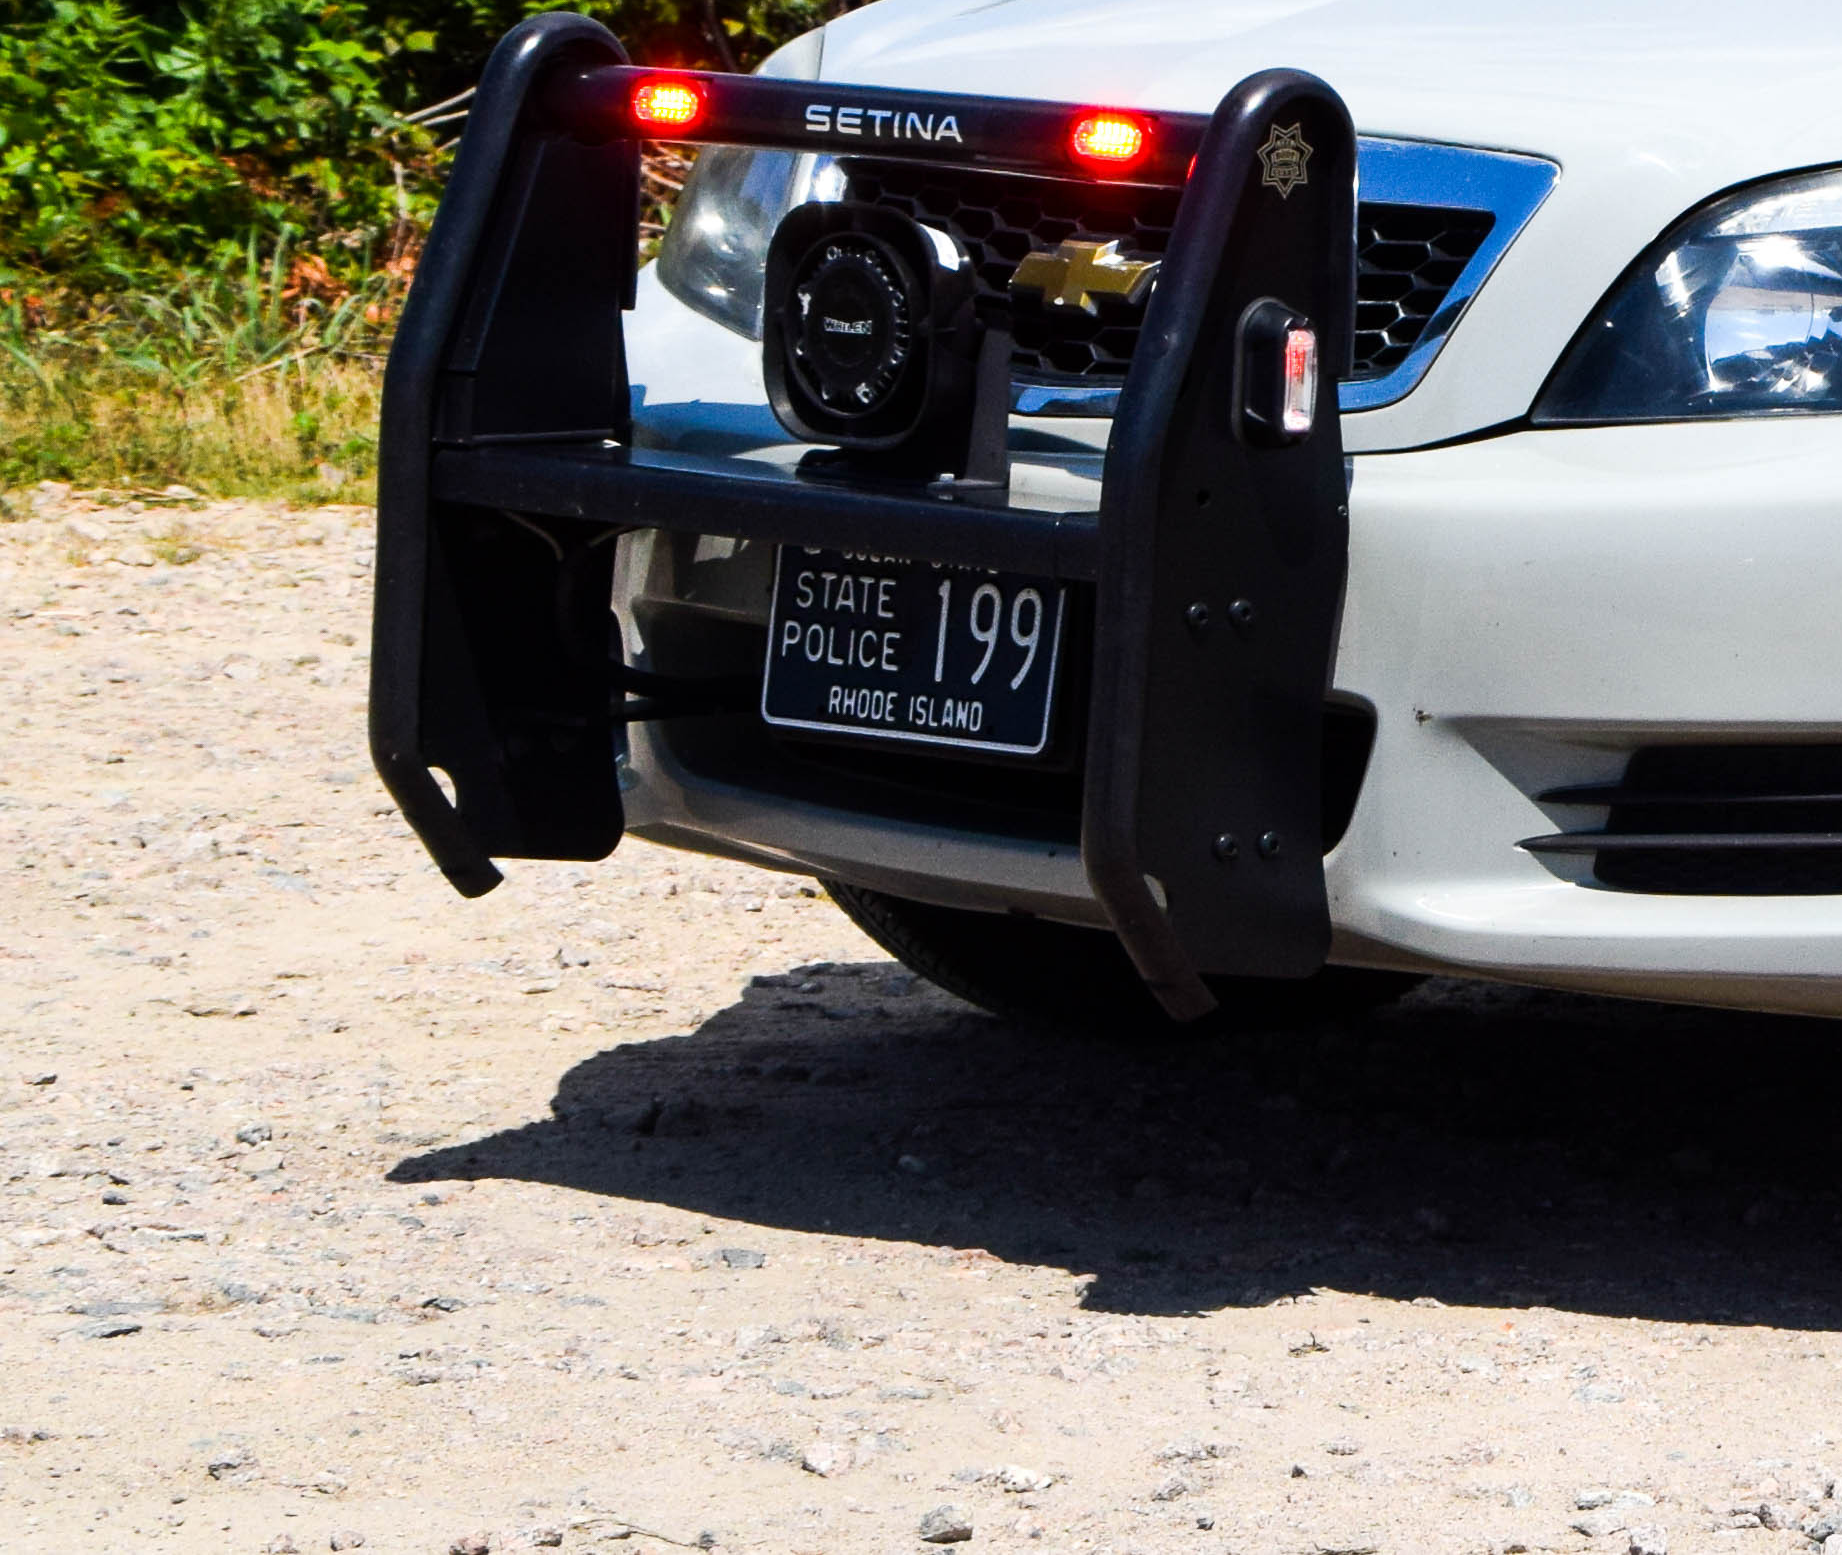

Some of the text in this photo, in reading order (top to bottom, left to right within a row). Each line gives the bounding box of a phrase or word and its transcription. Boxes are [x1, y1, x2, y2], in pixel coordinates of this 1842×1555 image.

[805, 104, 963, 143] SETINA
[781, 620, 903, 672] POLICE
[796, 570, 1043, 691] STATE 199
[829, 685, 984, 733] RHODE ISLAND
